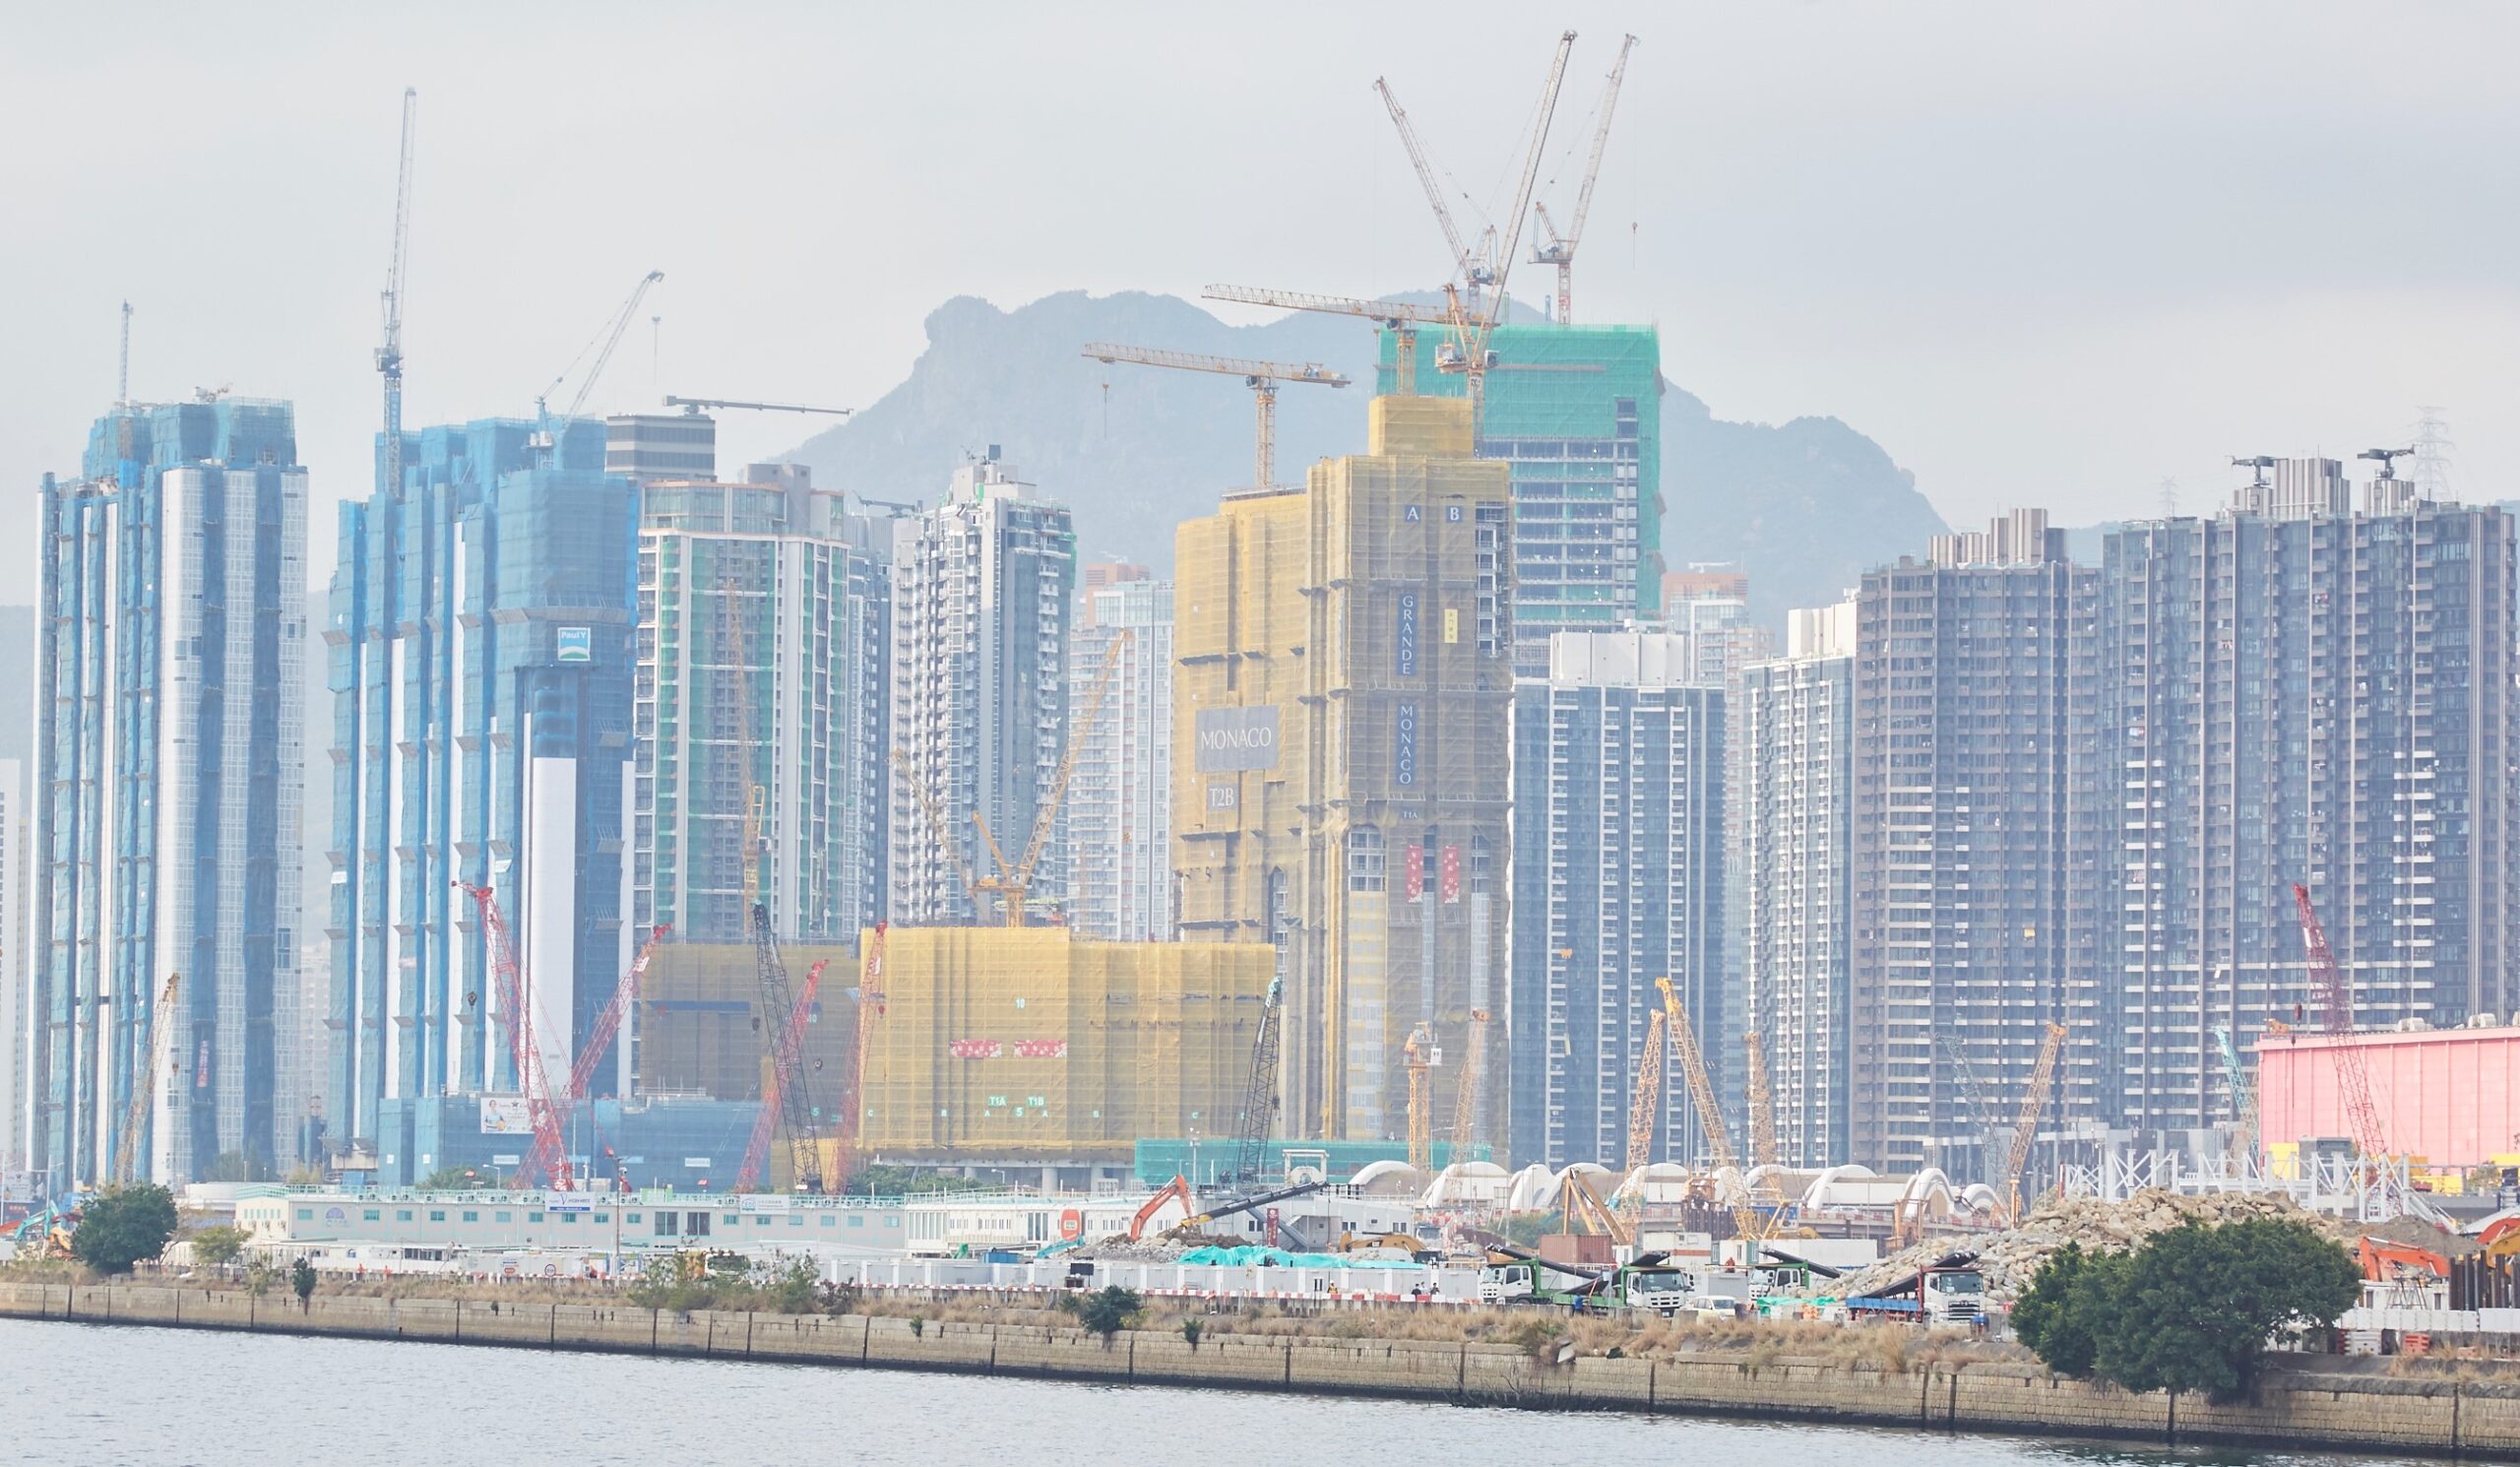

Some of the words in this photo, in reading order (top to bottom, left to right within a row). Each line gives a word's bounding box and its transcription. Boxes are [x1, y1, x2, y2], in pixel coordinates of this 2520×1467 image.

[1407, 506, 1419, 521] A
[1450, 506, 1460, 521] B
[1402, 595, 1414, 674] GRANDE
[1200, 727, 1272, 750] MONACO
[1400, 705, 1414, 785] MONACO
[1209, 787, 1234, 807] T2B
[1015, 998, 1026, 1009] 10
[989, 1096, 1008, 1108] T1A
[1028, 1096, 1044, 1107] T1B
[1016, 1107, 1024, 1117] 5
